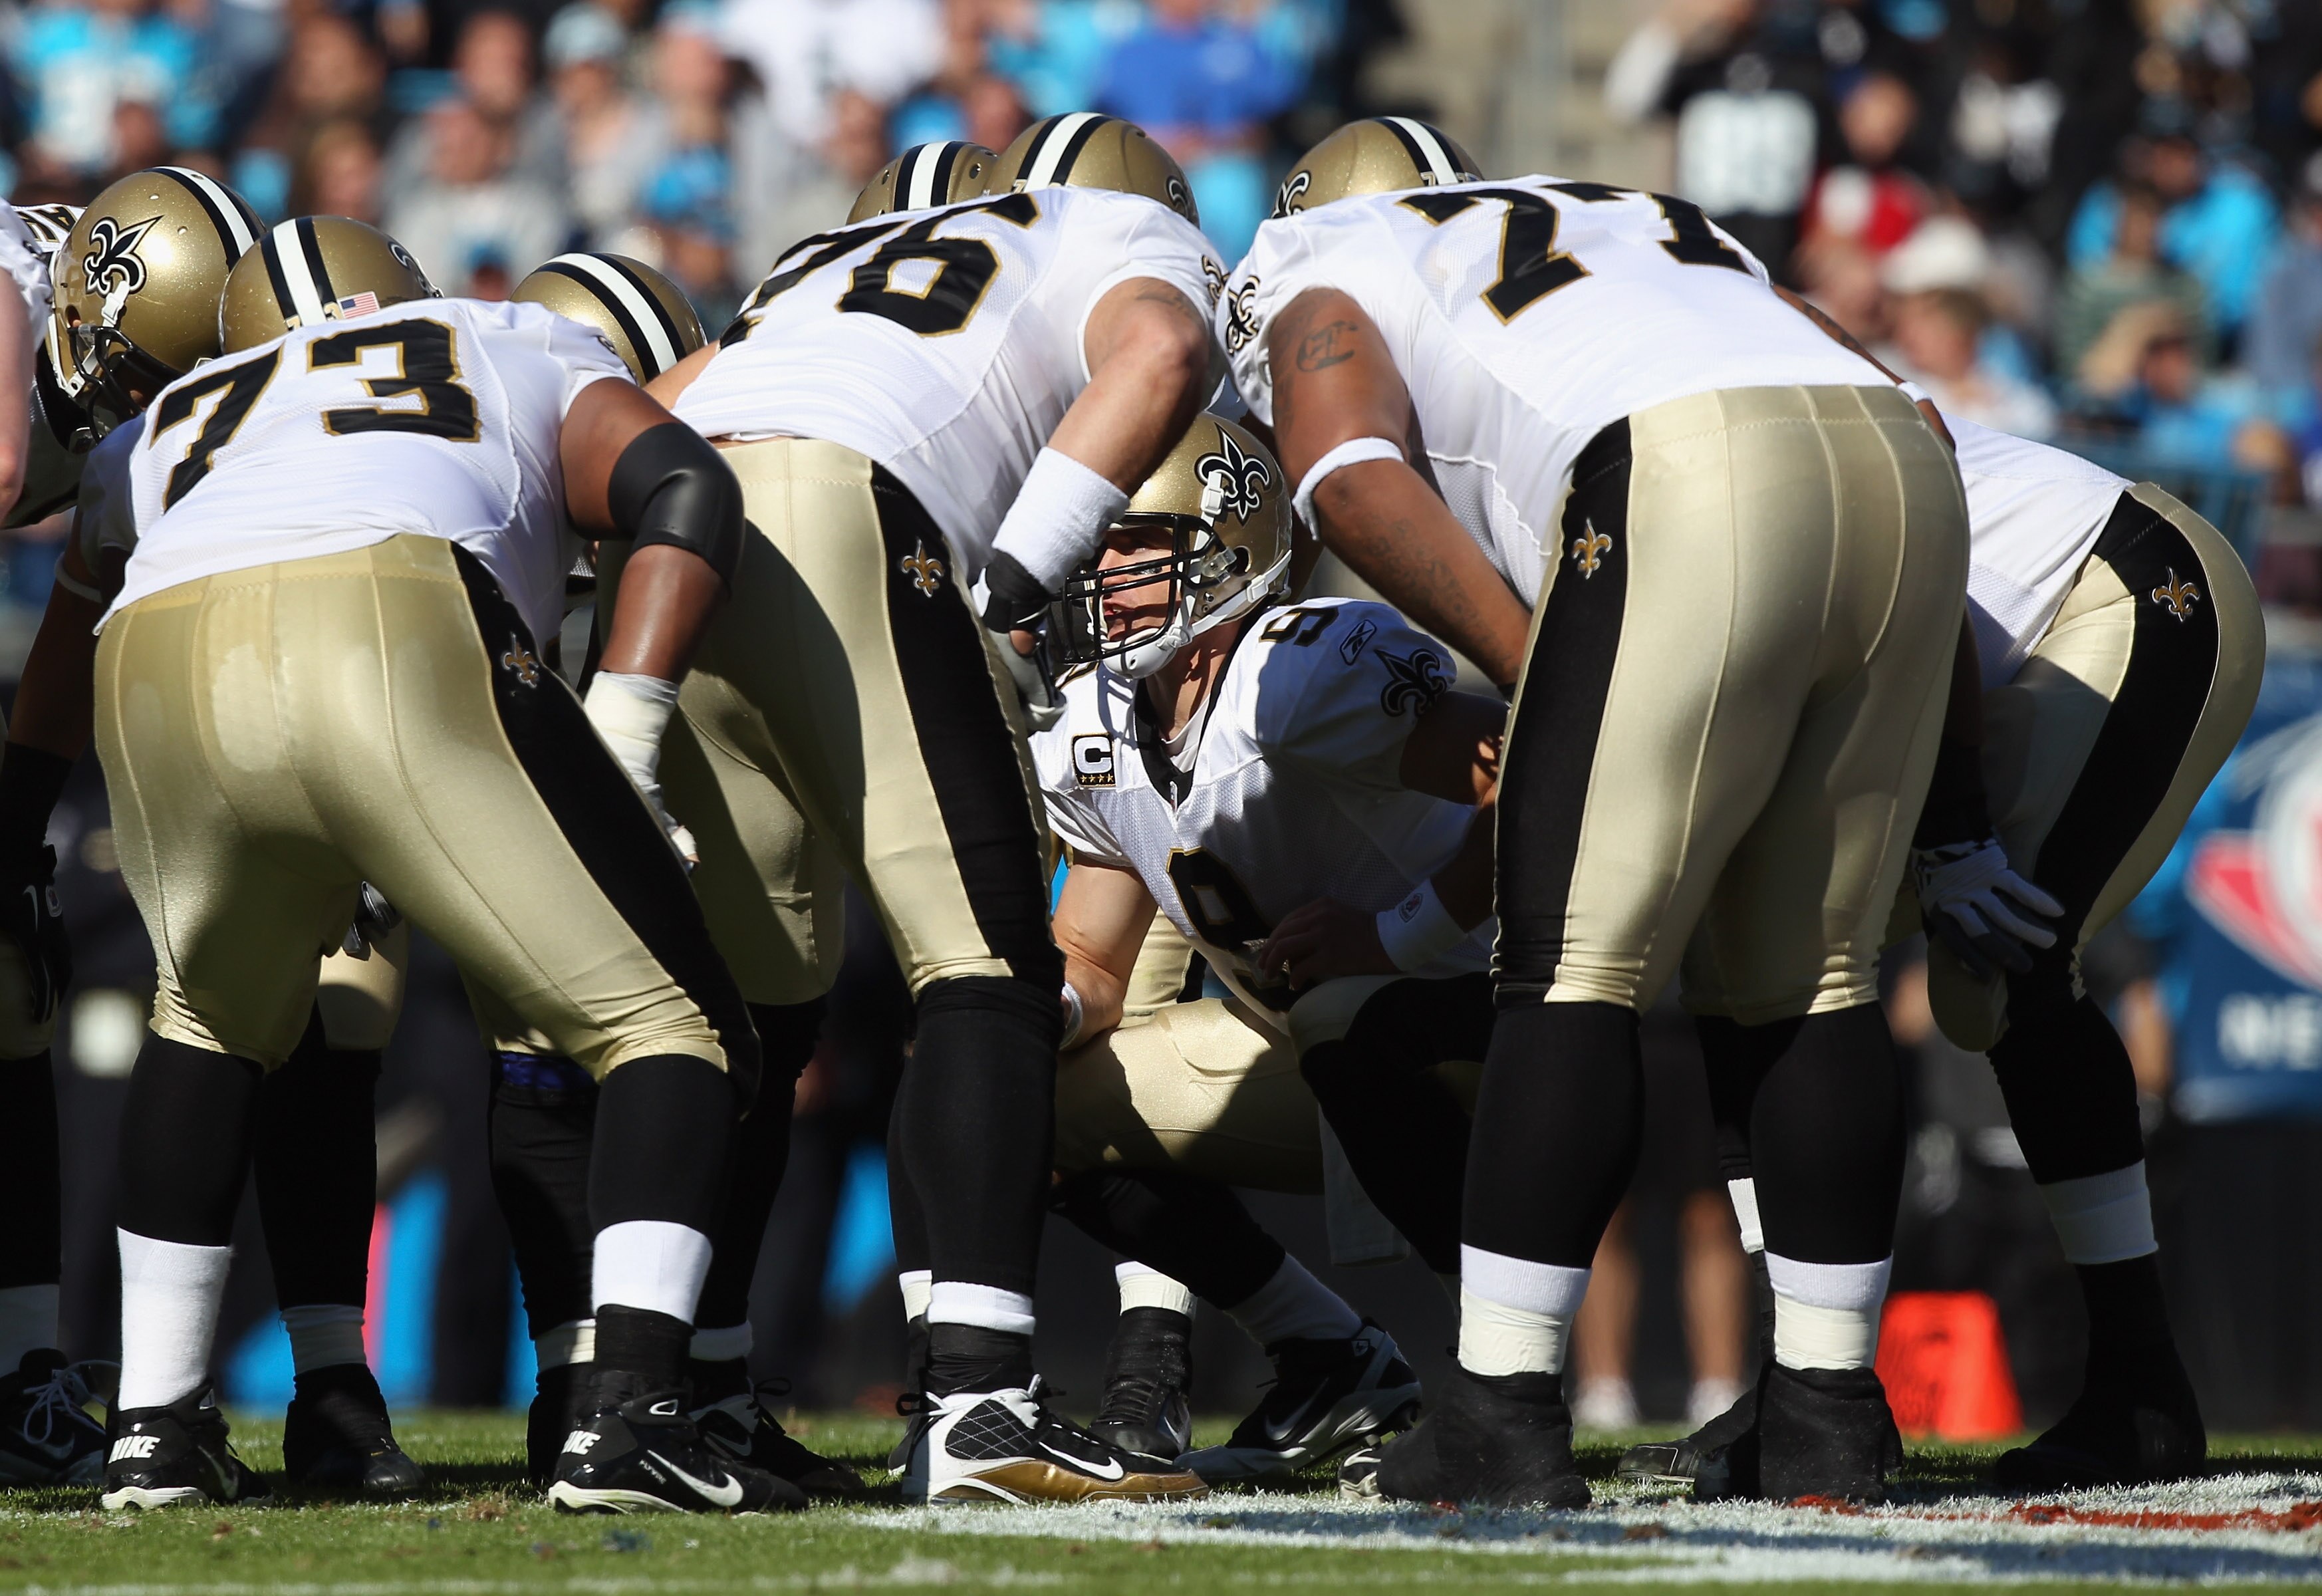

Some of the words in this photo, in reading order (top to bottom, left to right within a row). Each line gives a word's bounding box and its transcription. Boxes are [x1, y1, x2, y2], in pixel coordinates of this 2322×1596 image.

[718, 192, 1041, 351] 76
[148, 317, 481, 516] 73
[1074, 736, 1112, 774] C
[108, 1435, 161, 1464] NIKE
